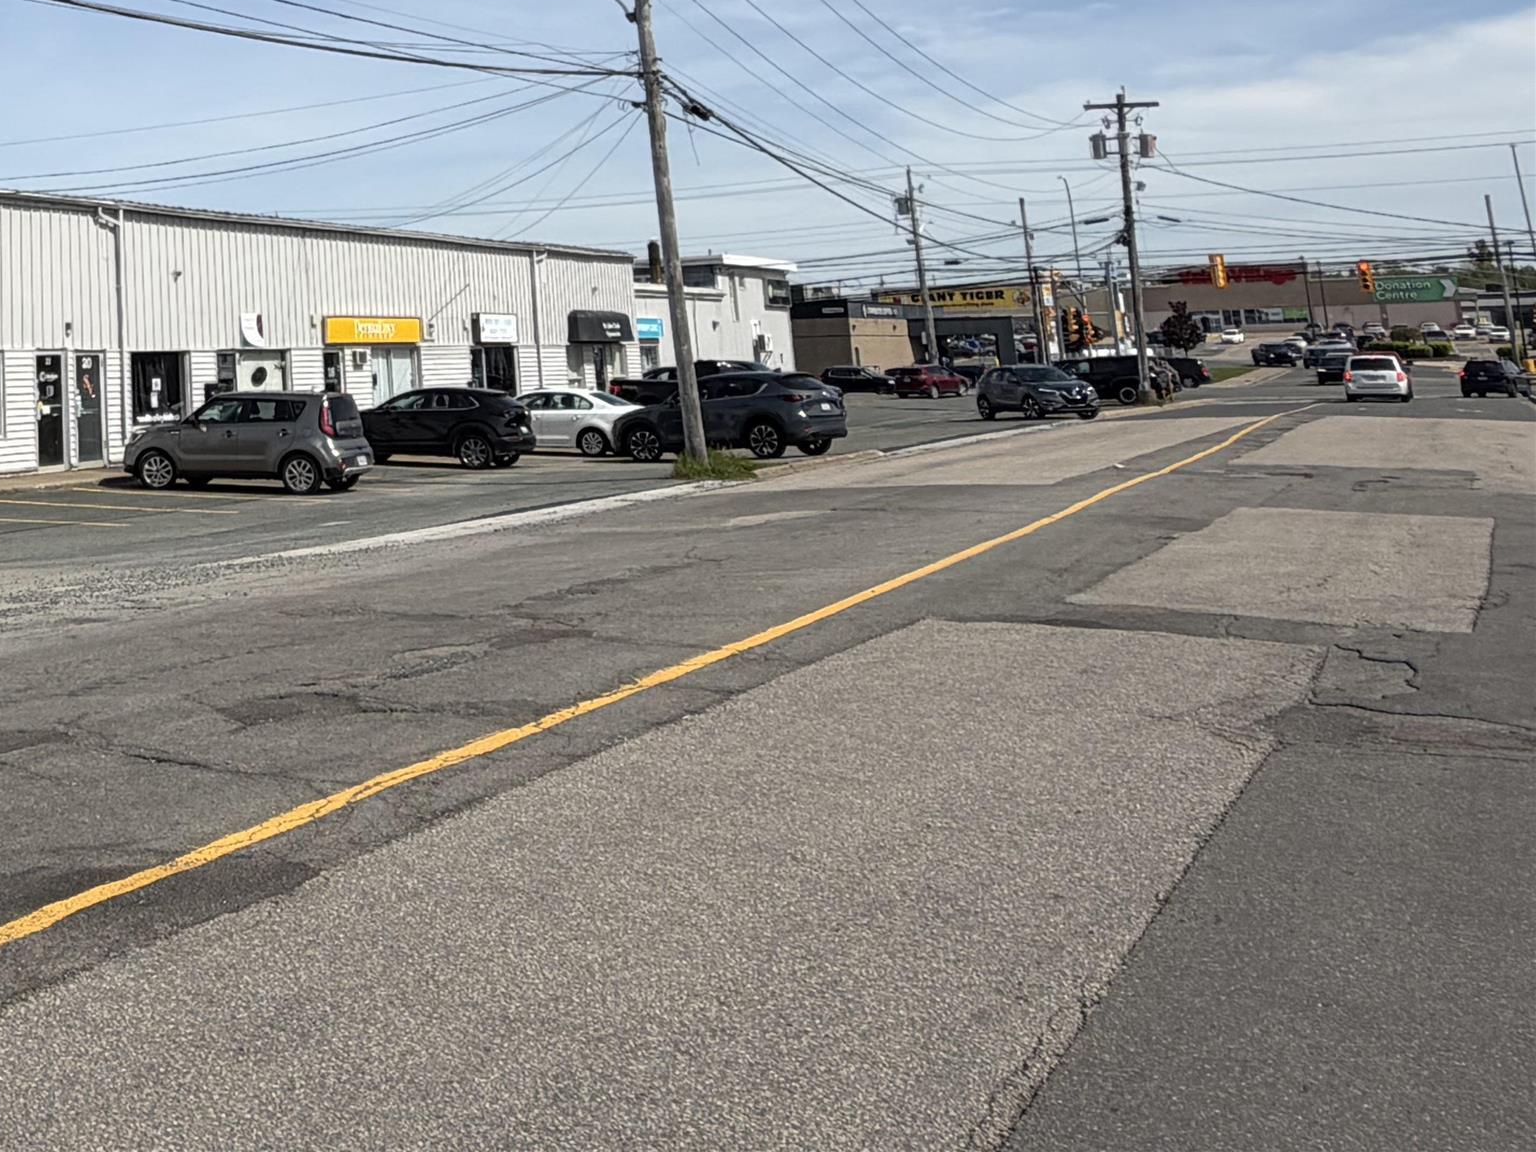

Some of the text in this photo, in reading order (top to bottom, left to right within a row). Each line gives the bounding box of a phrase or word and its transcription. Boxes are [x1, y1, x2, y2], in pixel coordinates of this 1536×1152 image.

[1375, 280, 1432, 291] Donation
[911, 290, 1005, 303] GANT TIGER
[1375, 291, 1418, 300] Centre
[81, 357, 93, 369] 20
